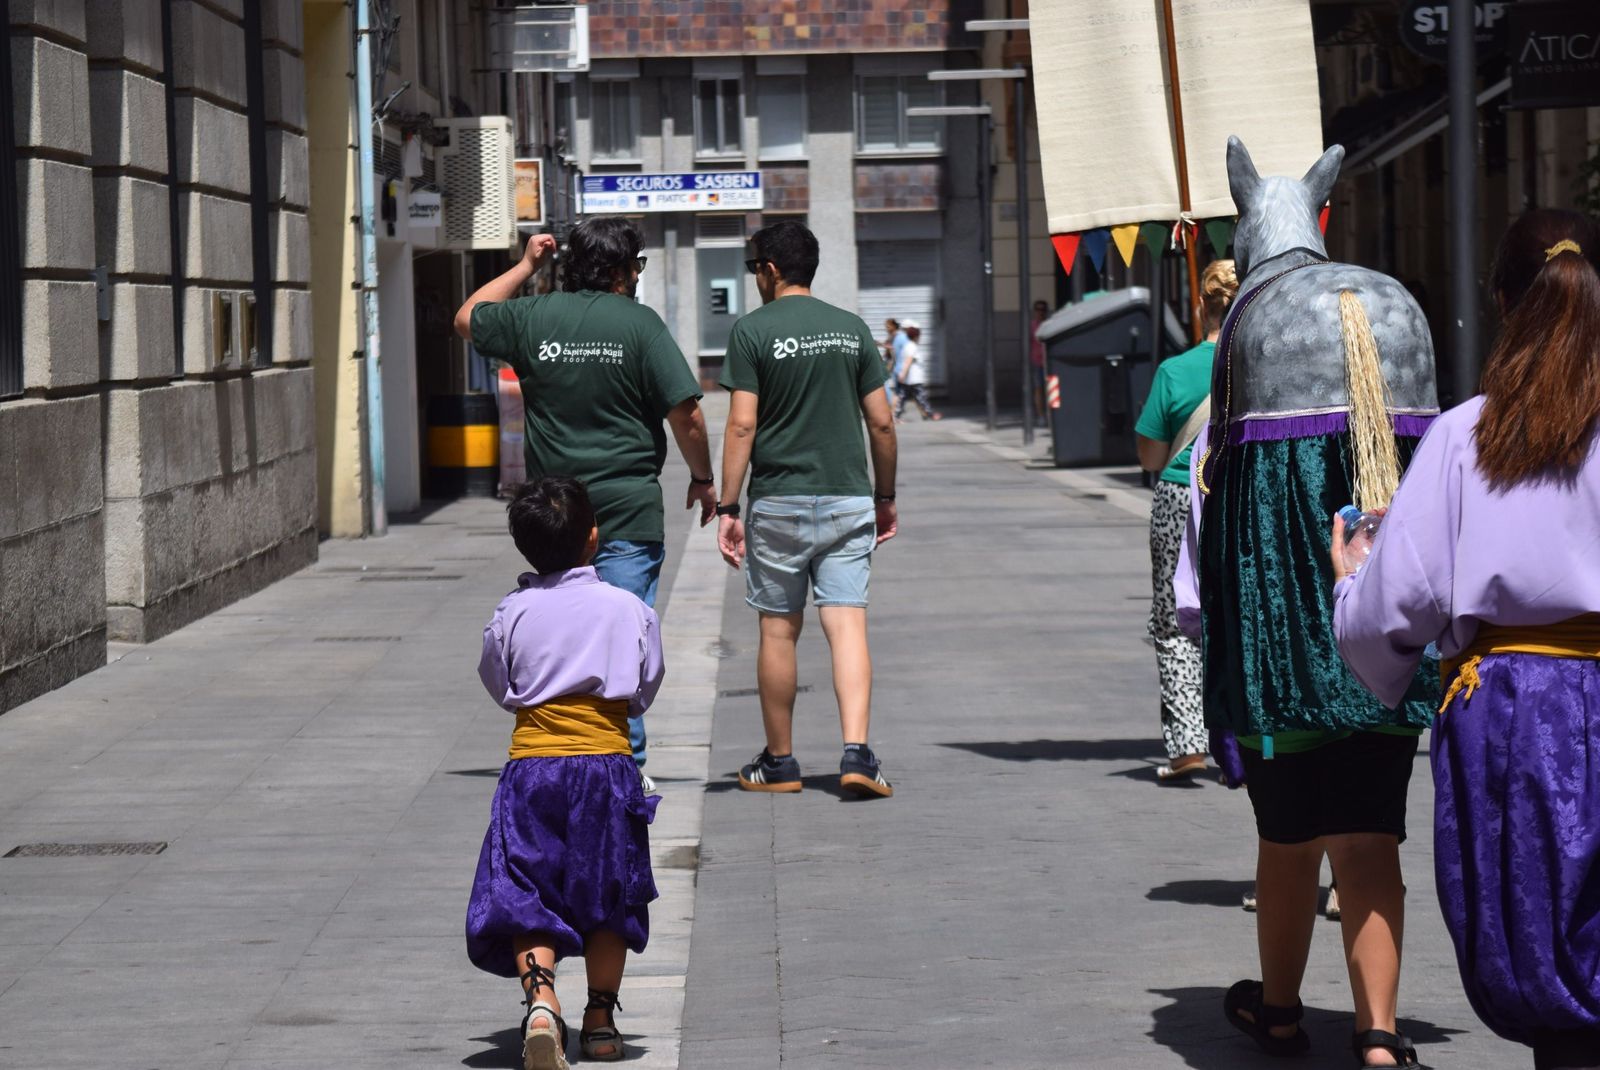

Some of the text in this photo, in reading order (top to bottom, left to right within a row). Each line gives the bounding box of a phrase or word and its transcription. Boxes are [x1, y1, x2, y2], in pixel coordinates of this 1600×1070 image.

[616, 174, 754, 191] SEGUROS SASBEN
[801, 332, 860, 341] ANIVERSARIO
[802, 348, 828, 357] 2005
